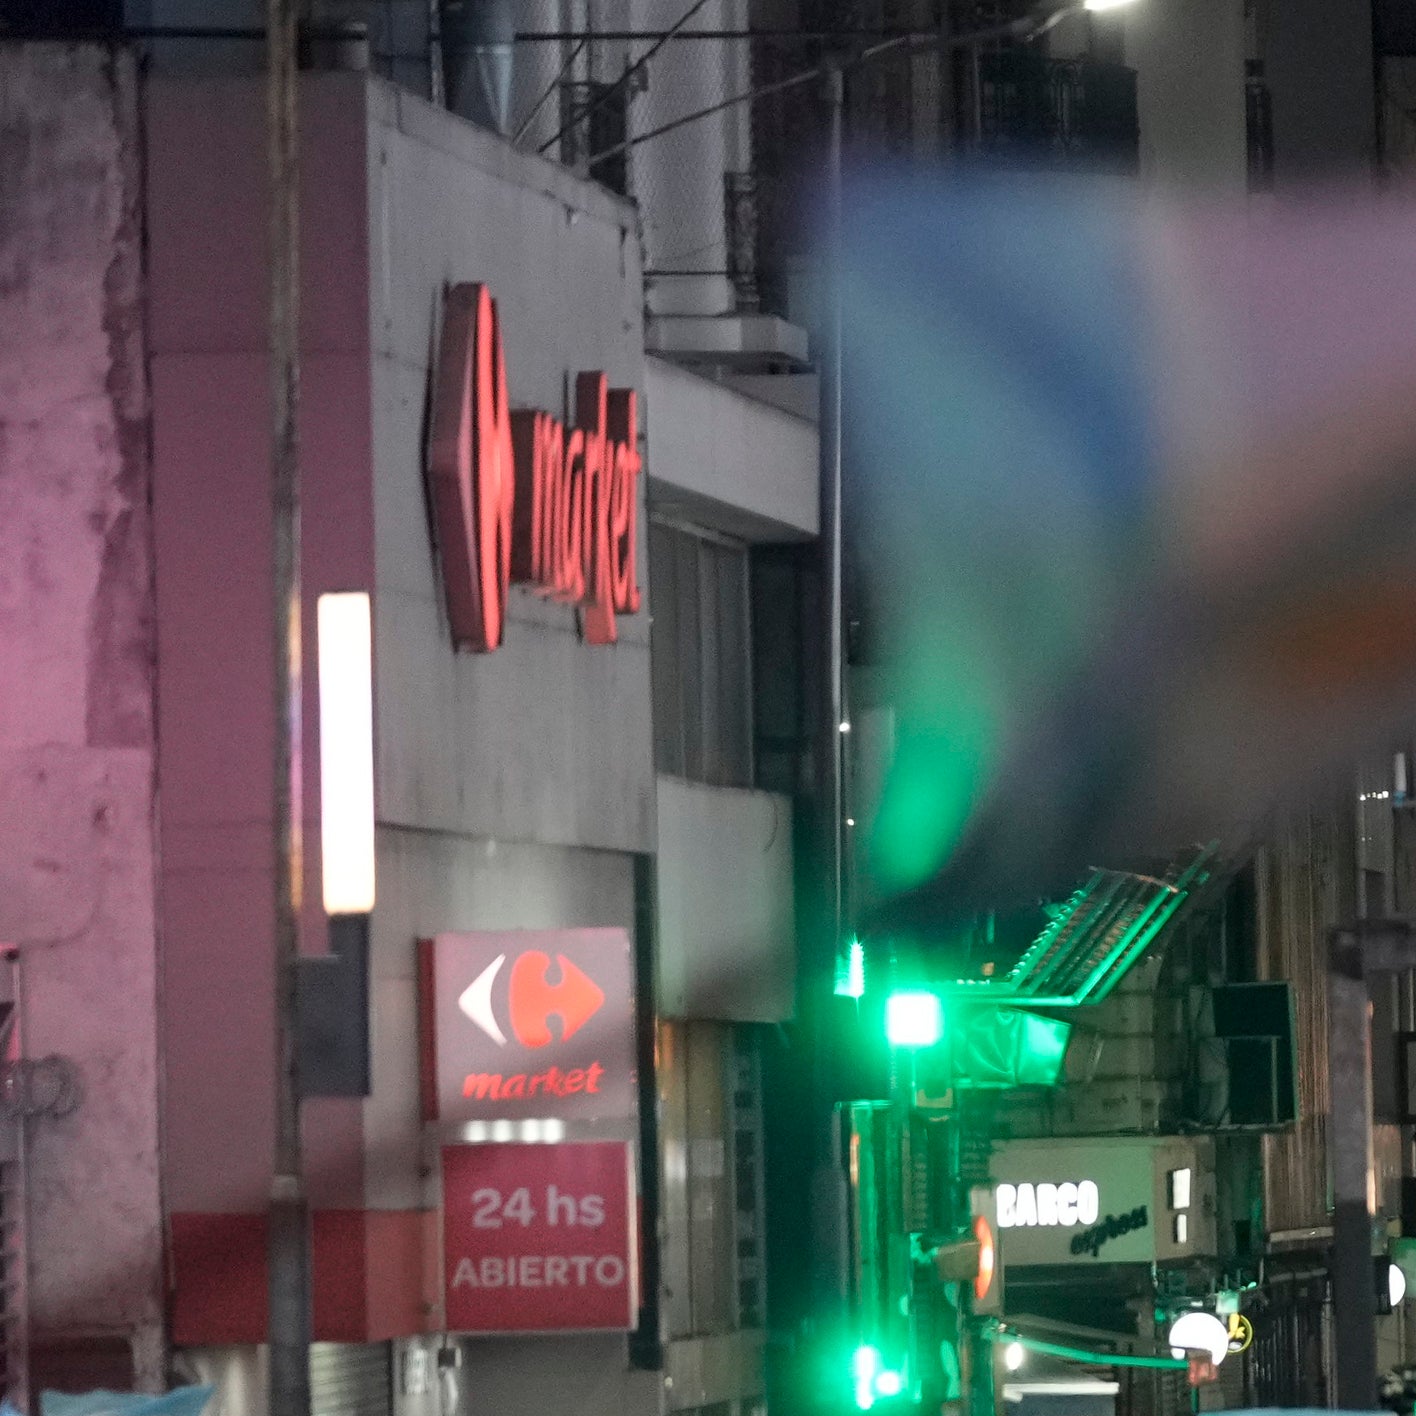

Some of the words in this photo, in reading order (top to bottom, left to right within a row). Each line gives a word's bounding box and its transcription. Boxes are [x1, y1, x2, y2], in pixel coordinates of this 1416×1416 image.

[462, 1061, 605, 1100] market
[472, 1187, 537, 1230] 24
[546, 1183, 607, 1228] hs
[996, 1179, 1099, 1228] BARCO
[453, 1254, 626, 1289] ABIERTO
